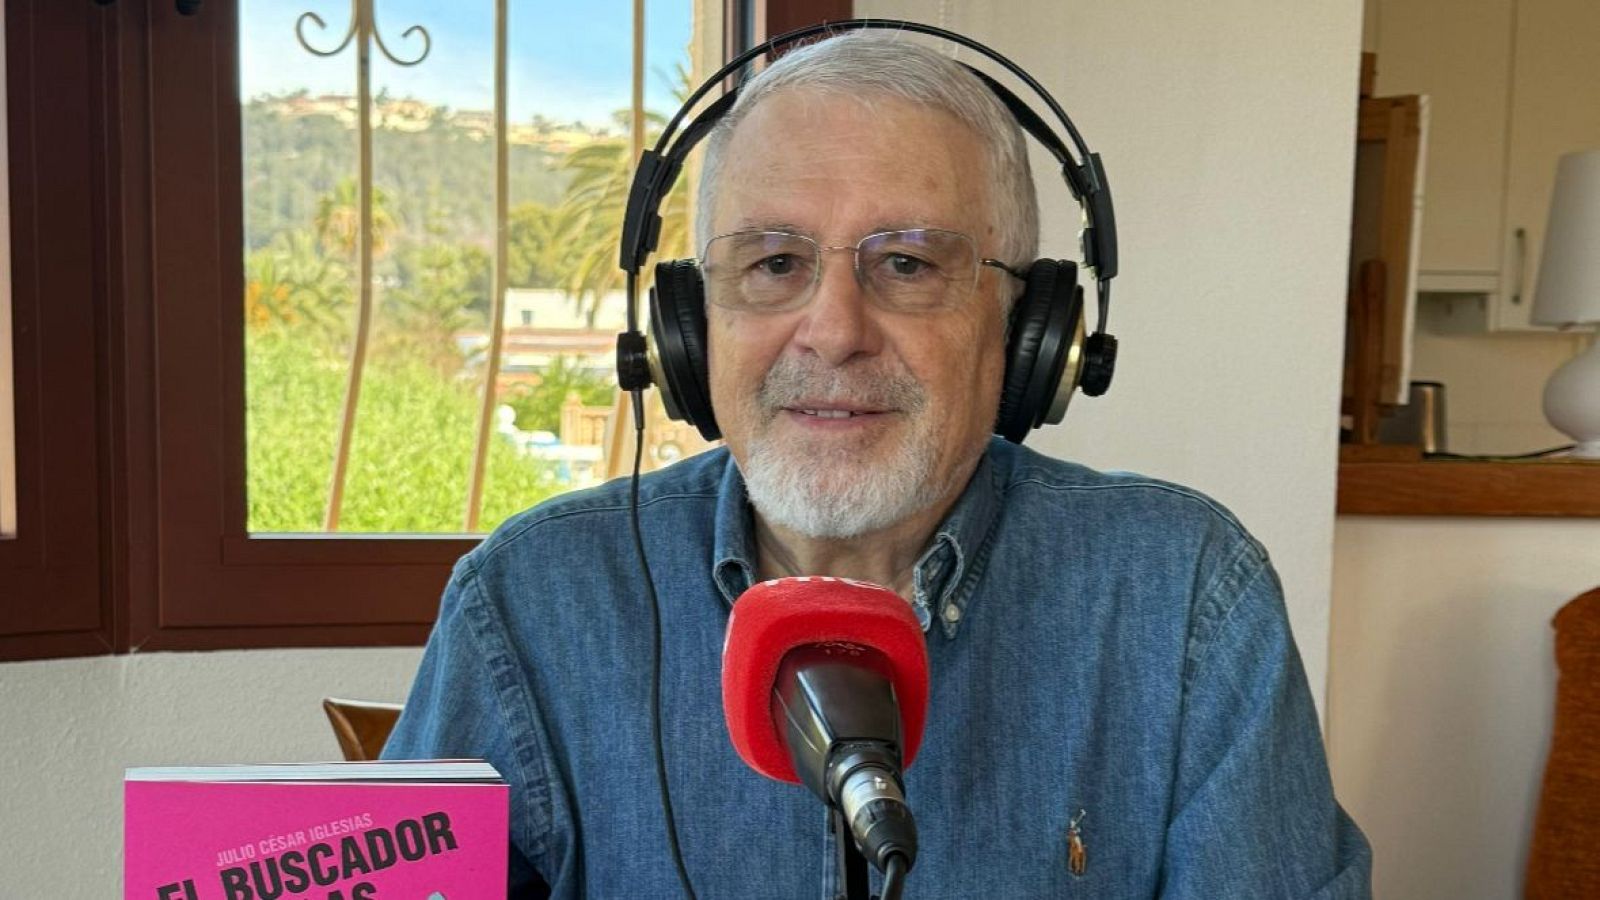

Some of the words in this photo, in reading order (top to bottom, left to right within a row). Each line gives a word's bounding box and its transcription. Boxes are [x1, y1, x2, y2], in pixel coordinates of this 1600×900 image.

[216, 843, 256, 867] JULIO
[258, 830, 307, 855] CÉSAR
[308, 812, 374, 842] IGLESIAS
[220, 811, 459, 900] BUSCADOR
